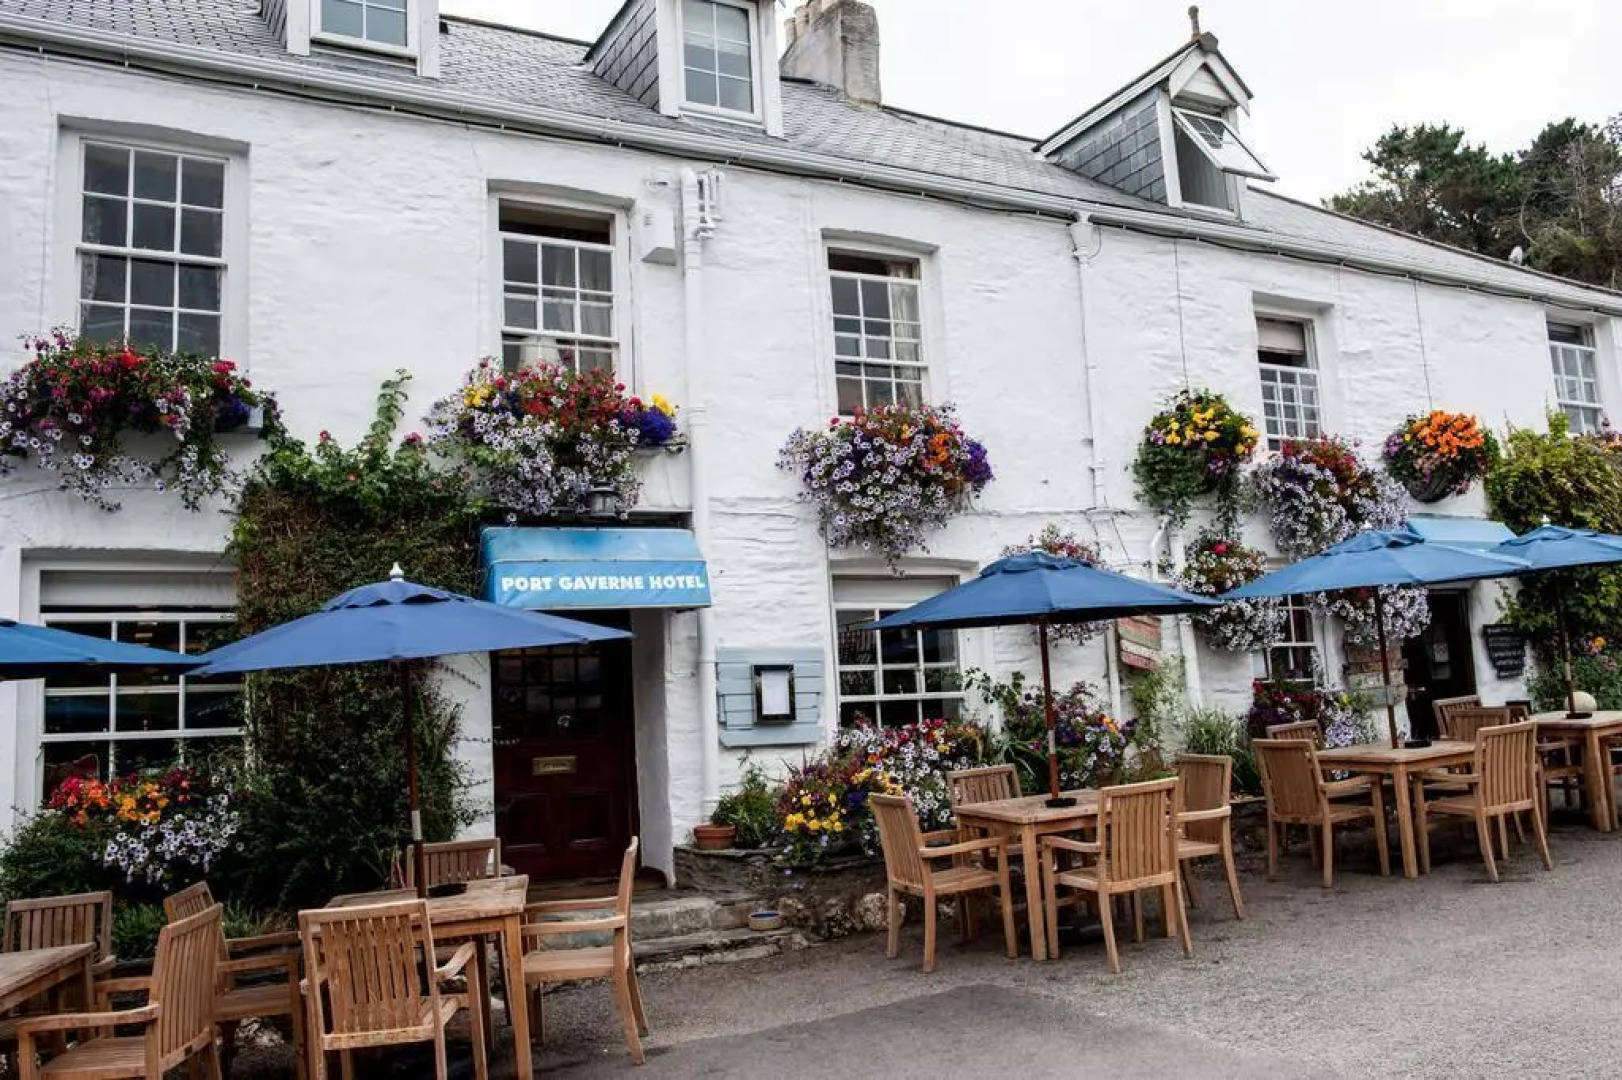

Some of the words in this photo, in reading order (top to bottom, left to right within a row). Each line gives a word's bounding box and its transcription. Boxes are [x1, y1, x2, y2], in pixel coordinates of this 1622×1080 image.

[501, 576, 553, 592] PORT
[558, 574, 644, 591] GAVERNE
[649, 573, 706, 590] HOTEL
